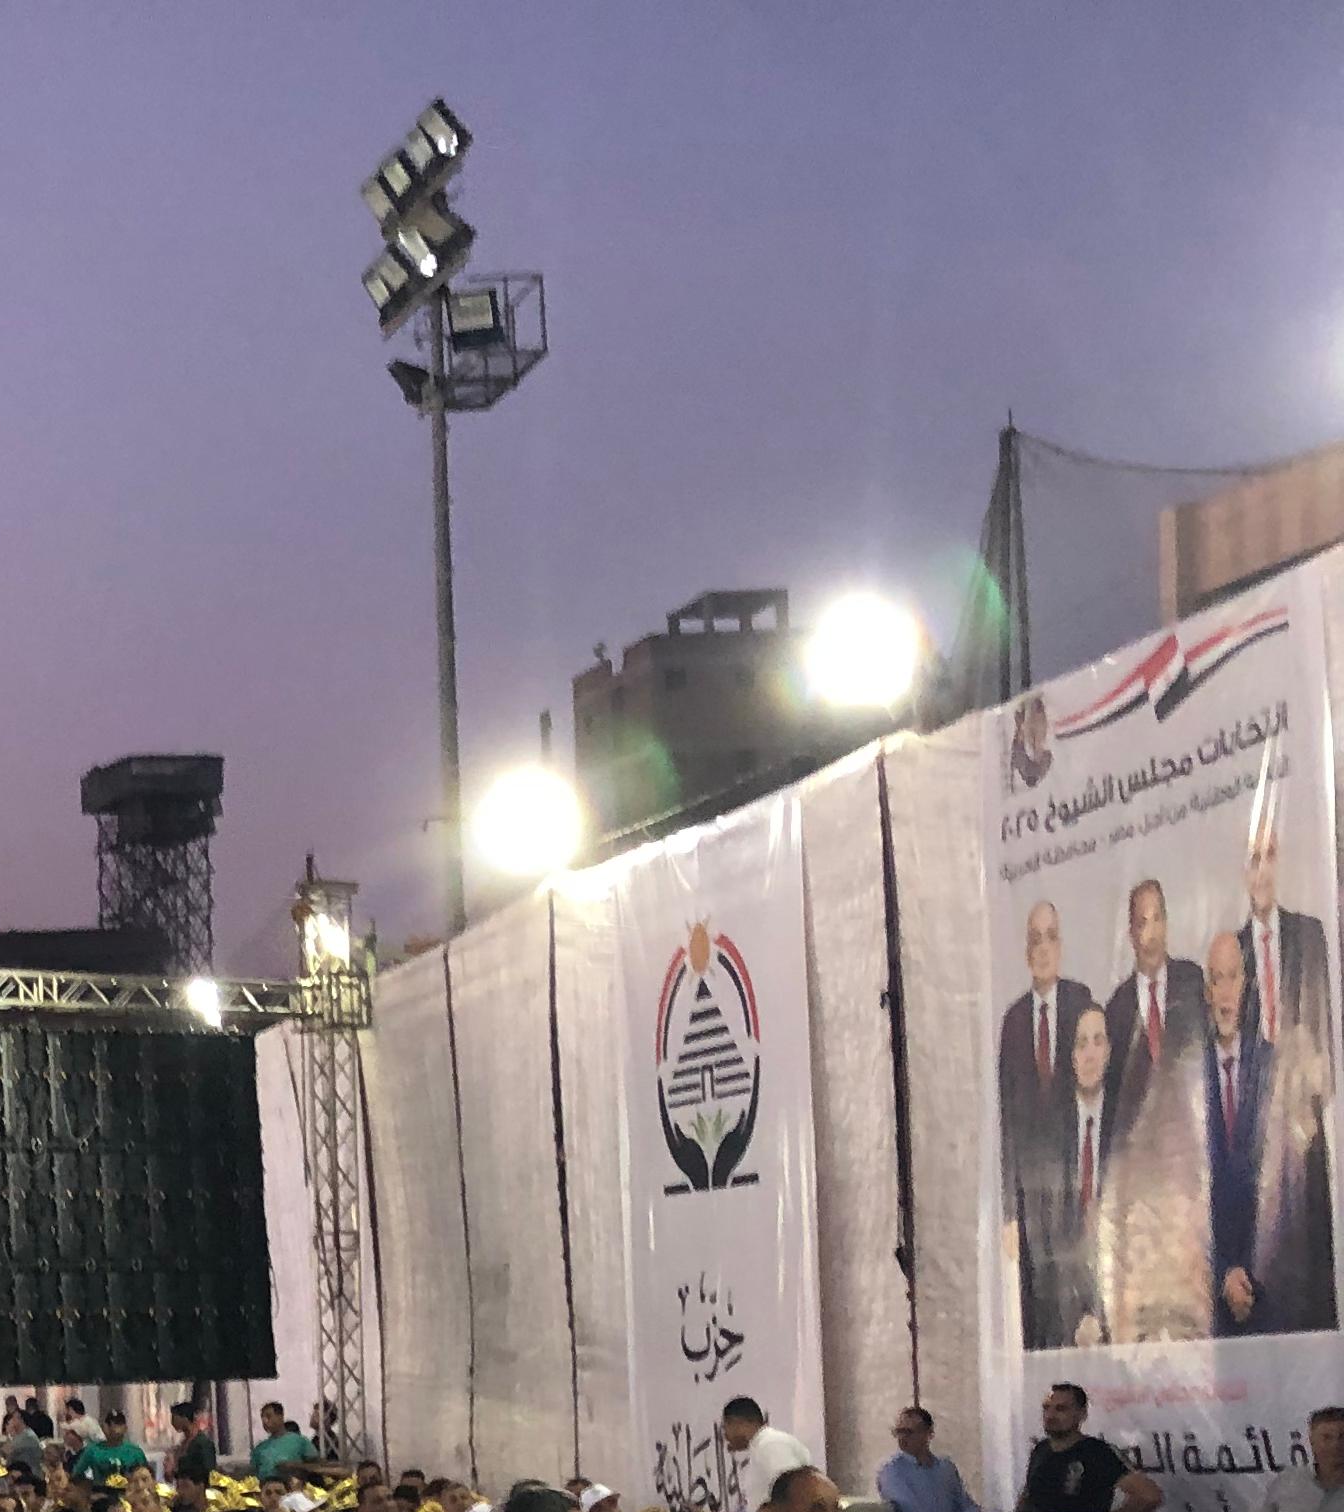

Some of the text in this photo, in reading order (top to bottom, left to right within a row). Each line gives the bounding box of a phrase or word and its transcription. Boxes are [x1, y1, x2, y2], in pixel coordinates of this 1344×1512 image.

[1197, 699, 1289, 765] انتخابات
[1044, 773, 1114, 834] الشيوخ
[1118, 754, 1193, 804] مجلس
[1001, 808, 1039, 843] ٢٠٢٥
